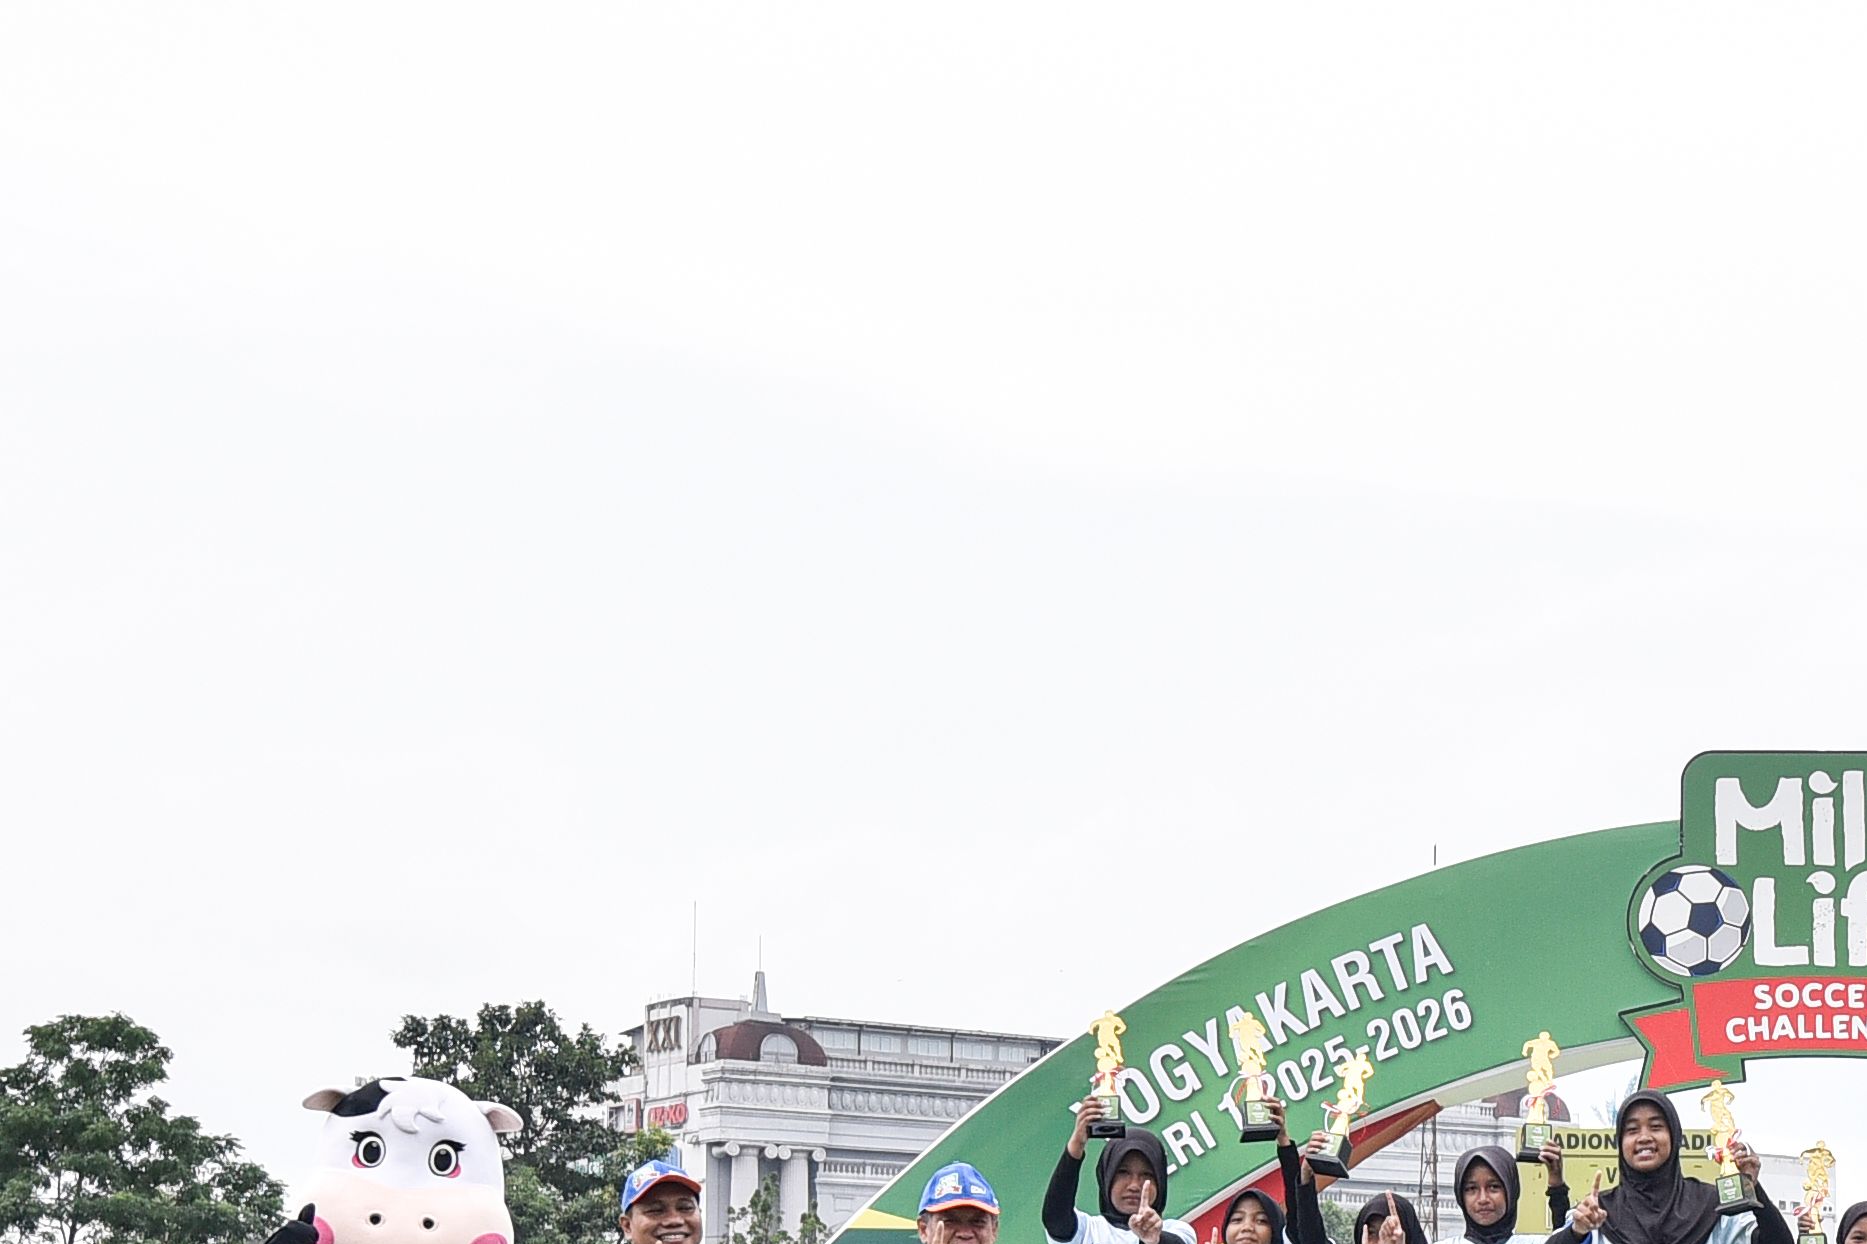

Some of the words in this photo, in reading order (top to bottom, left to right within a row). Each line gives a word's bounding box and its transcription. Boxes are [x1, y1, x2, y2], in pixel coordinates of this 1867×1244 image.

[646, 1015, 682, 1053] XXI
[1069, 922, 1456, 1126] OGYAKARTA
[1553, 1132, 1617, 1150] ADION
